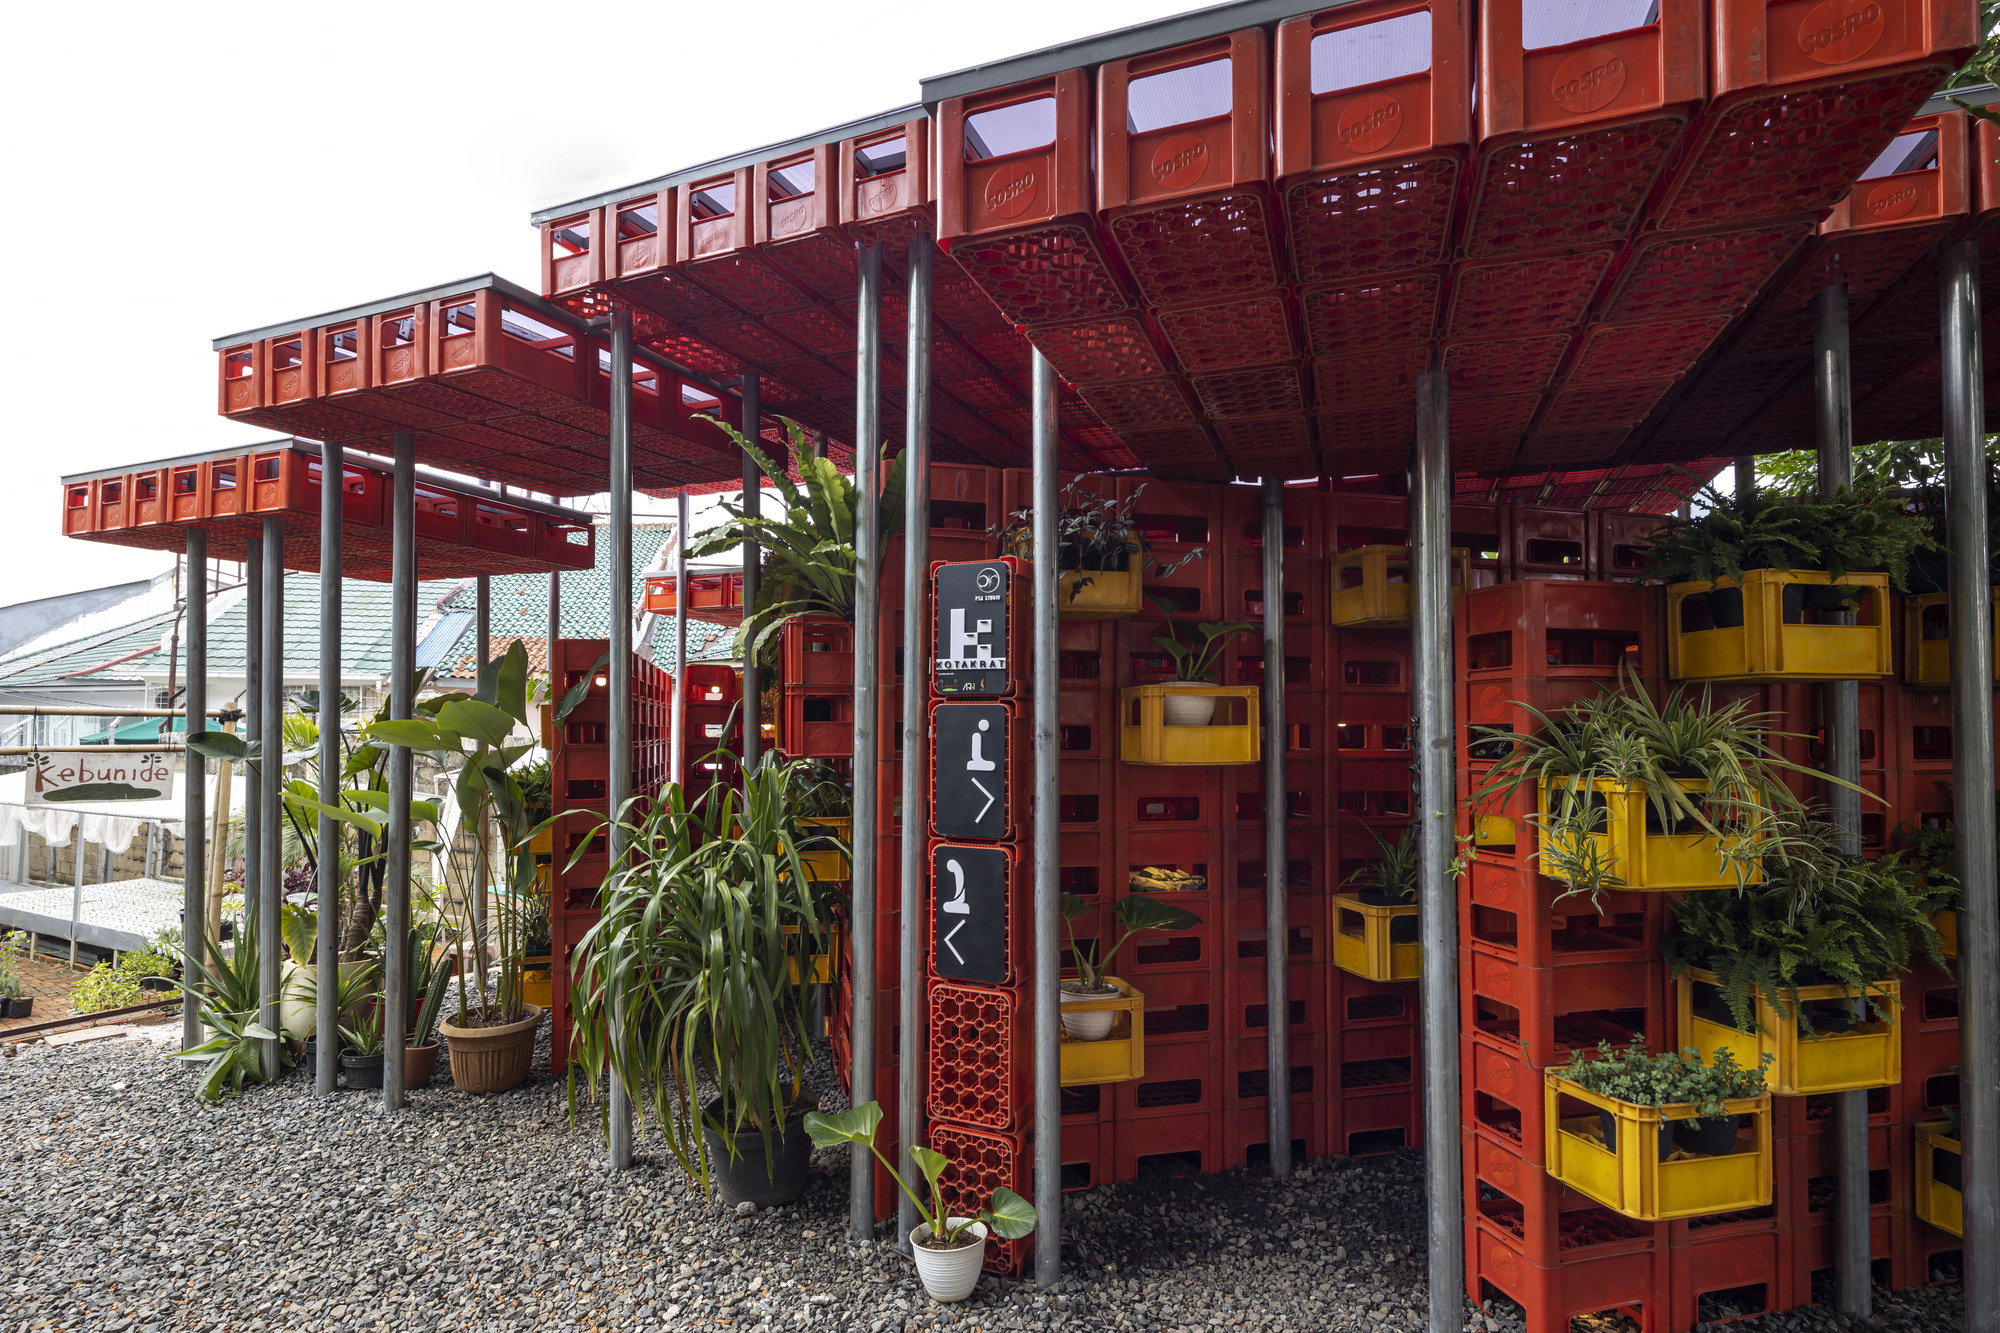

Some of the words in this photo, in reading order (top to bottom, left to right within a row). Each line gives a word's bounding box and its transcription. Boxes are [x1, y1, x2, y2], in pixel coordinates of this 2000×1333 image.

[1803, 4, 1880, 57] SOSRO
[1554, 57, 1623, 103] SOSRO
[1341, 101, 1400, 146] SOSRO
[1153, 141, 1207, 184] SOSRO
[988, 171, 1034, 212] SOSRO
[936, 660, 1005, 669] KOTAKRAT
[34, 757, 169, 793] Kebunide
